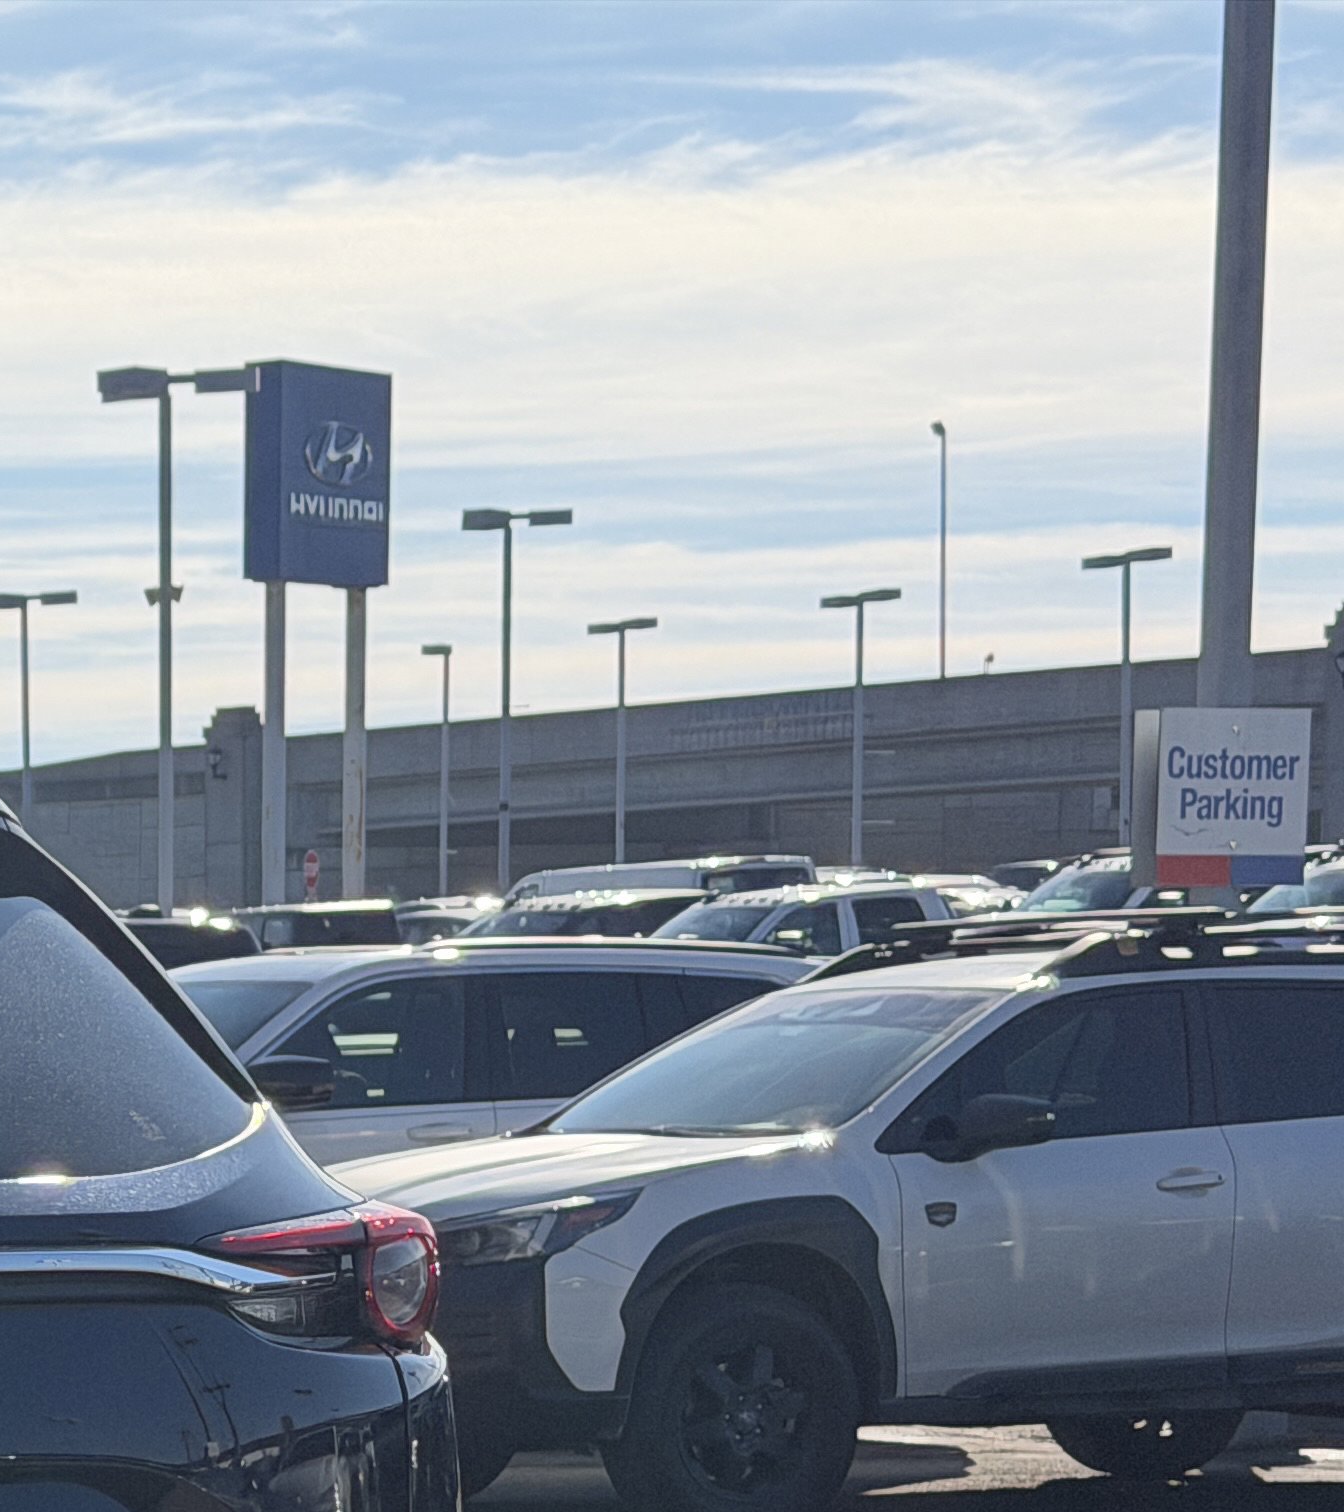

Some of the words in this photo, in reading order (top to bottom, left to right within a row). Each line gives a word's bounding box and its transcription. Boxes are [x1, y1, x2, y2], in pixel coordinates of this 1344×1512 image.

[290, 491, 384, 522] HYUNDAI
[1167, 745, 1300, 781] Customer
[1180, 787, 1283, 828] Parking
